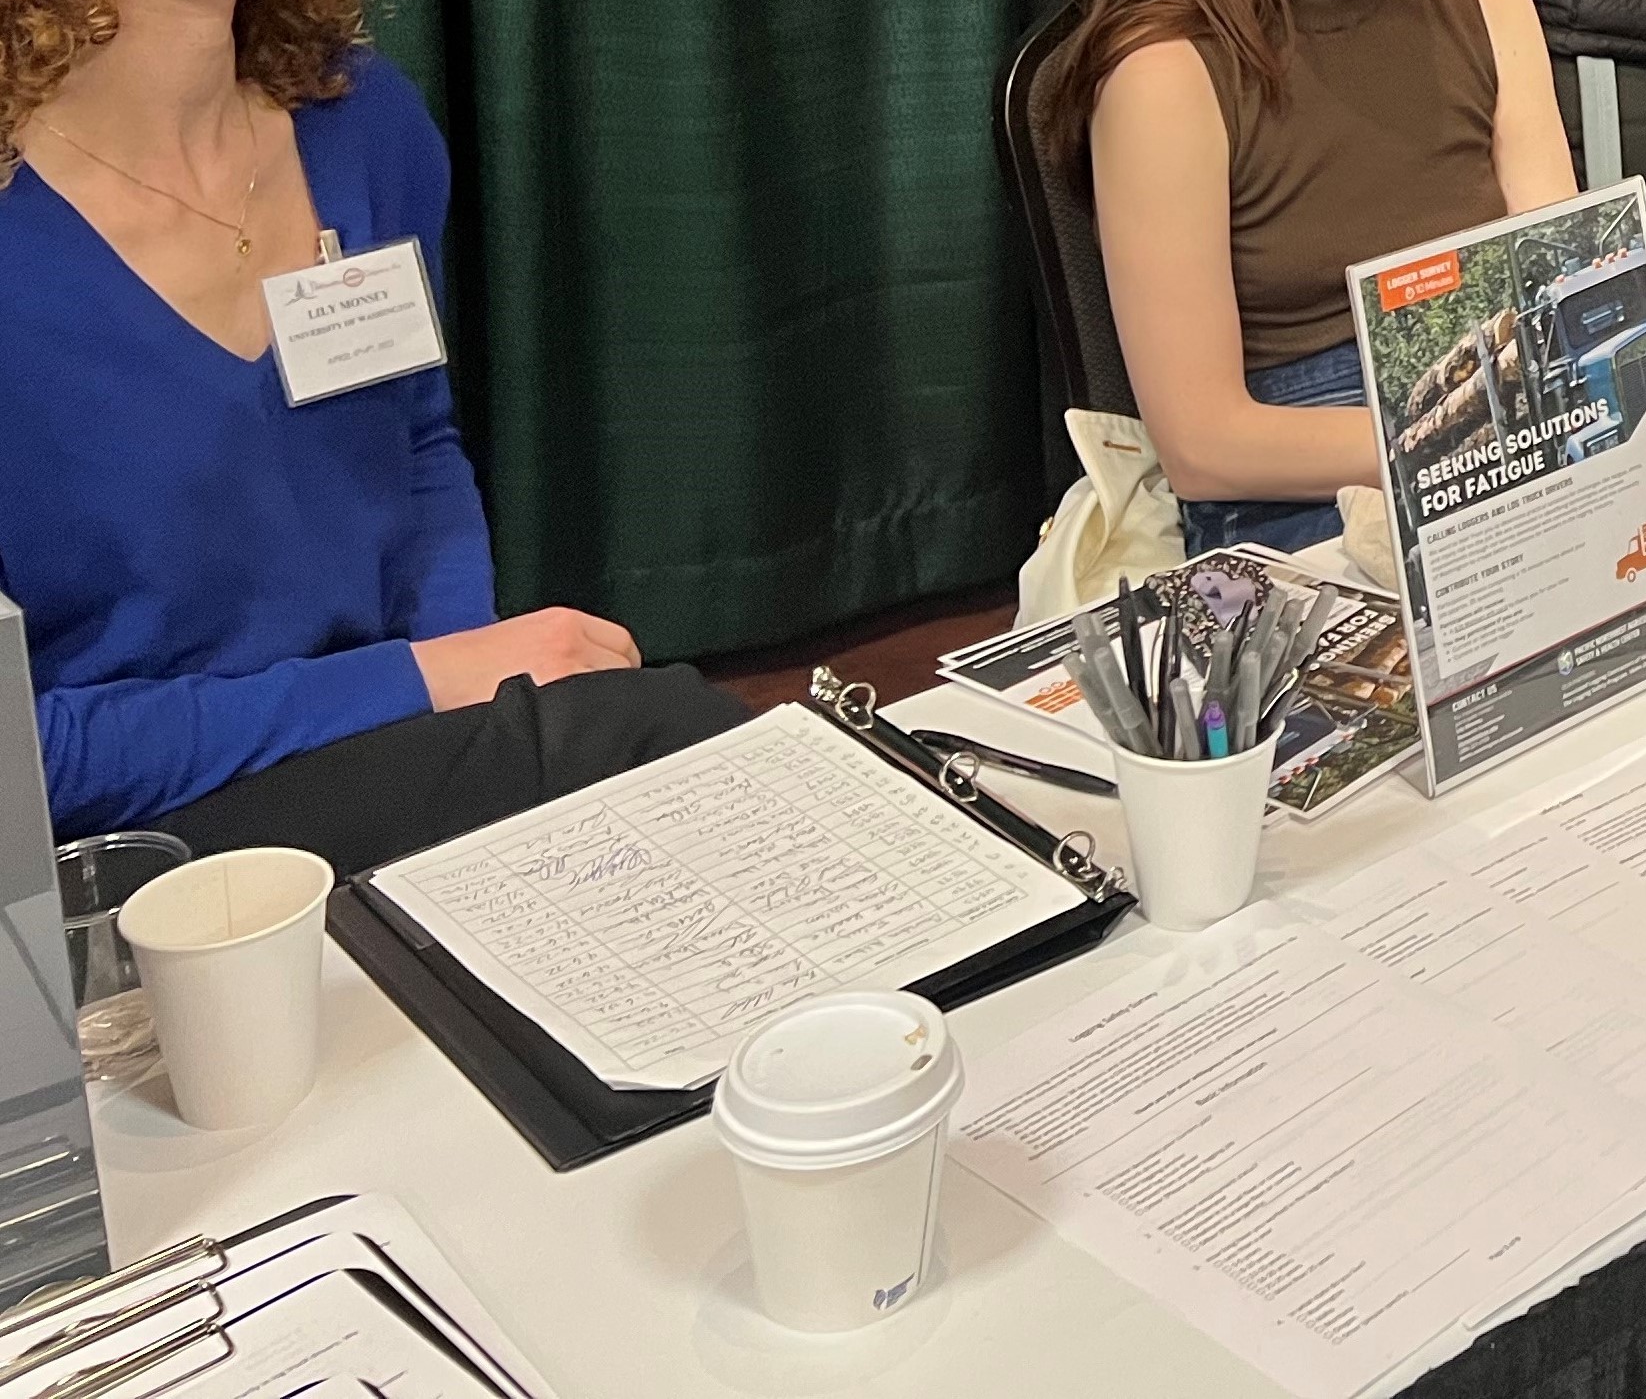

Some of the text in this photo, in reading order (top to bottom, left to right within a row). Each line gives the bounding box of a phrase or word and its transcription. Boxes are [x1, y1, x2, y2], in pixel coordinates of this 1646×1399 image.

[288, 322, 343, 343] UNIVERSITY
[358, 301, 416, 323] WASHINGTON
[307, 303, 338, 320] LILY
[1416, 398, 1610, 490] SEEKING SOLUTIONS
[1421, 449, 1546, 518] FOR FATIGUE
[1426, 523, 1457, 545] CALLING
[1491, 506, 1506, 518] AND
[1435, 572, 1479, 599] CONTRIBUTE
[1501, 553, 1524, 571] STORY
[1452, 683, 1498, 712] CONTACT US
